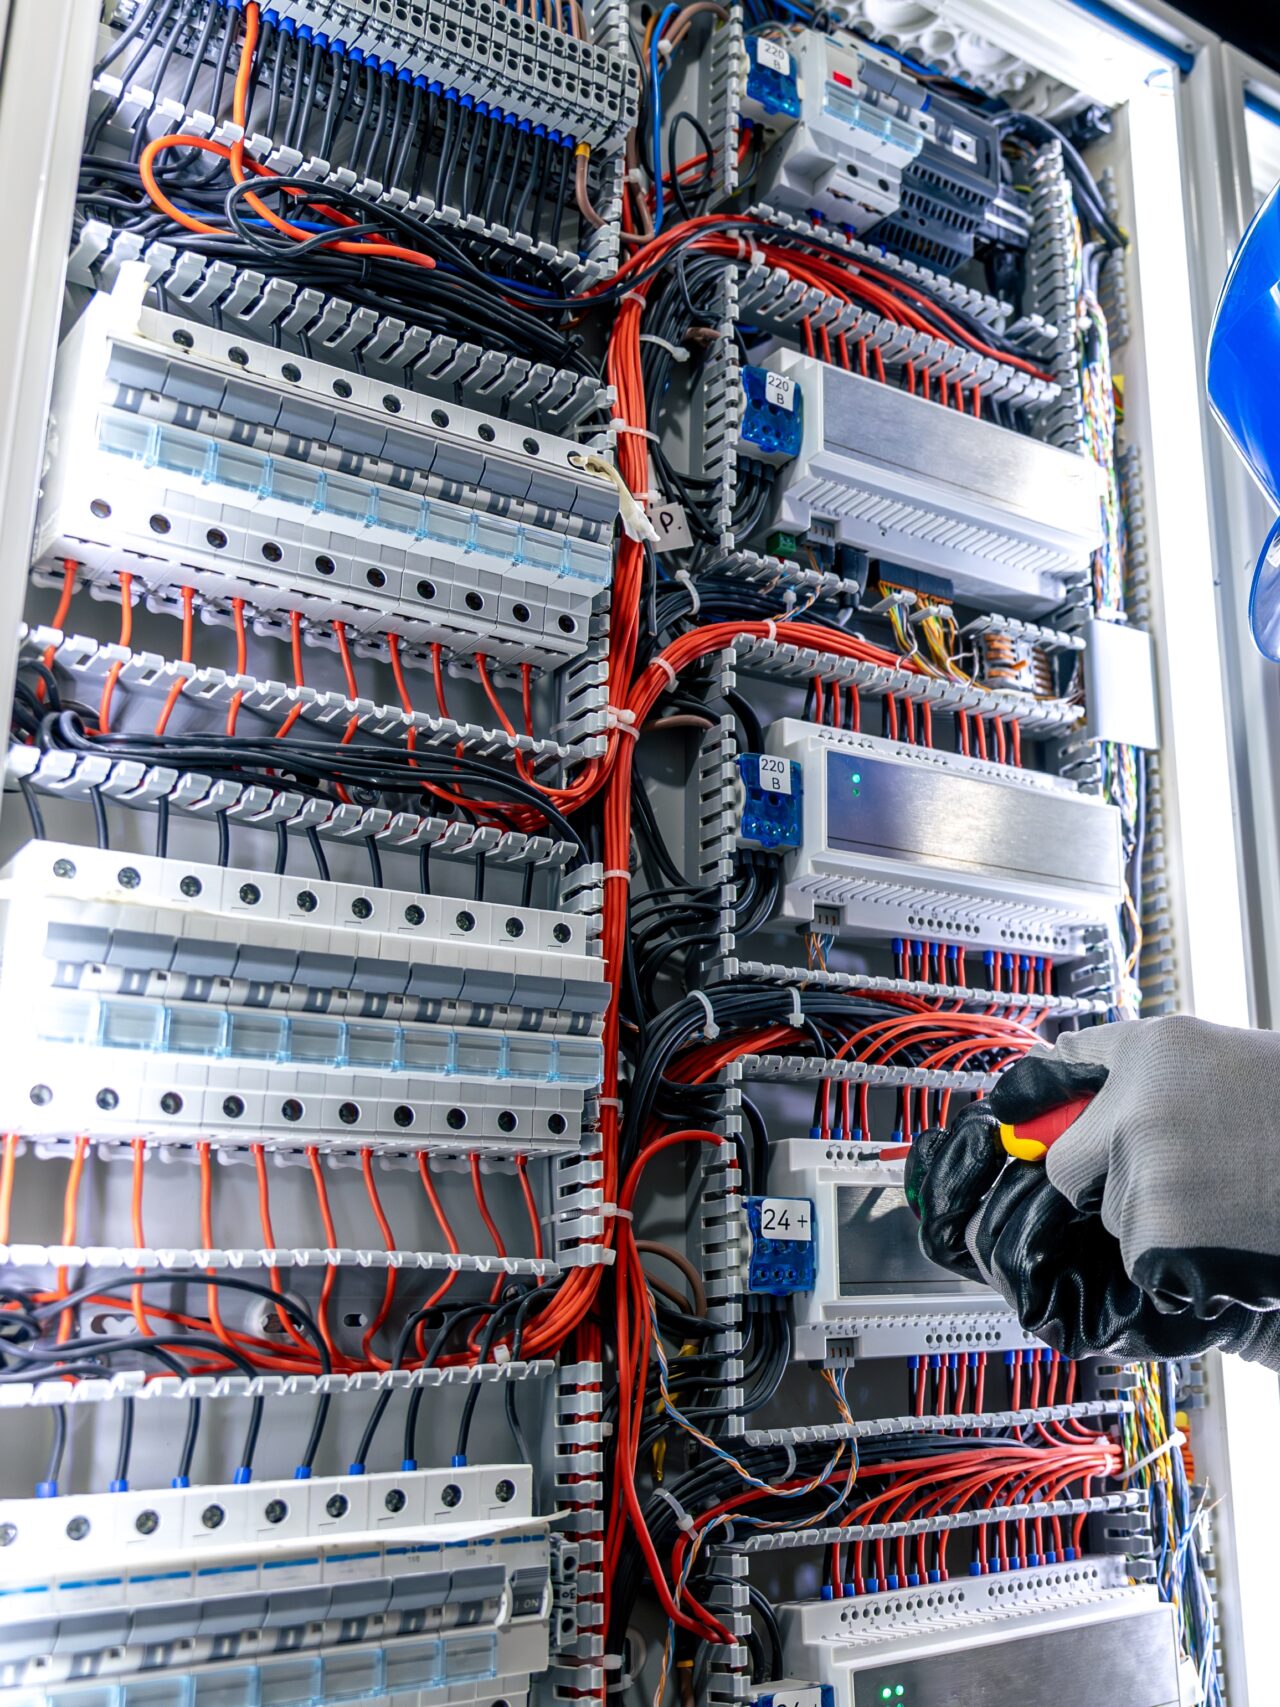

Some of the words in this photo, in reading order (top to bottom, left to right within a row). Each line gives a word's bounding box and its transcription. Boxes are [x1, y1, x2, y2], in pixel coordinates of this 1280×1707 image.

[765, 43, 784, 60] 220
[768, 375, 789, 392] 220
[777, 393, 785, 405] B
[761, 758, 785, 774] 220
[772, 777, 781, 790] B
[523, 1598, 539, 1609] ON
